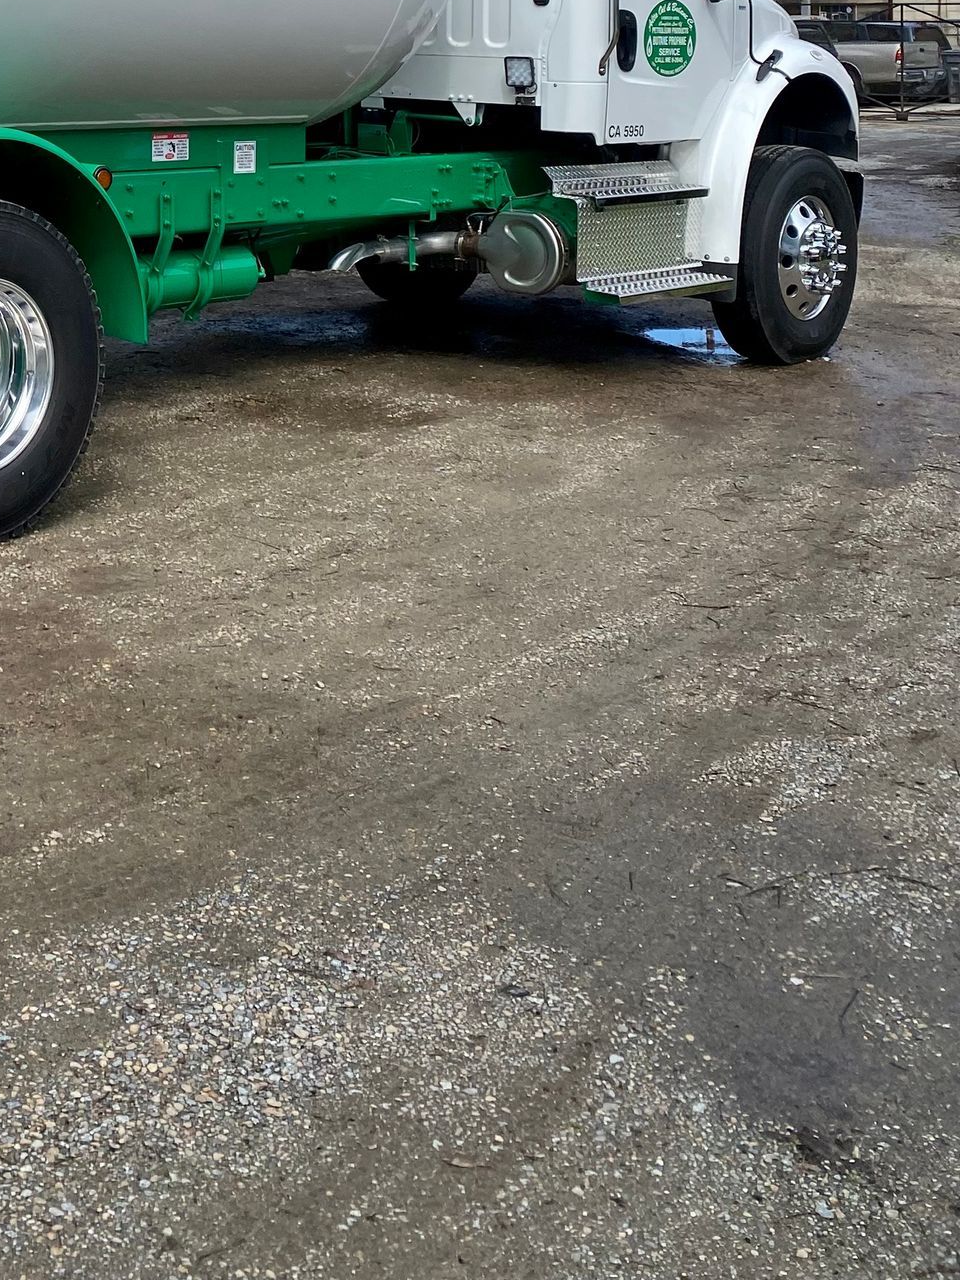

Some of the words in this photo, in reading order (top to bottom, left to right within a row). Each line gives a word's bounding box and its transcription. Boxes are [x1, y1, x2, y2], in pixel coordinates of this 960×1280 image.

[658, 47, 681, 57] SERVICE
[608, 125, 621, 138] CA
[623, 124, 645, 138] 5950
